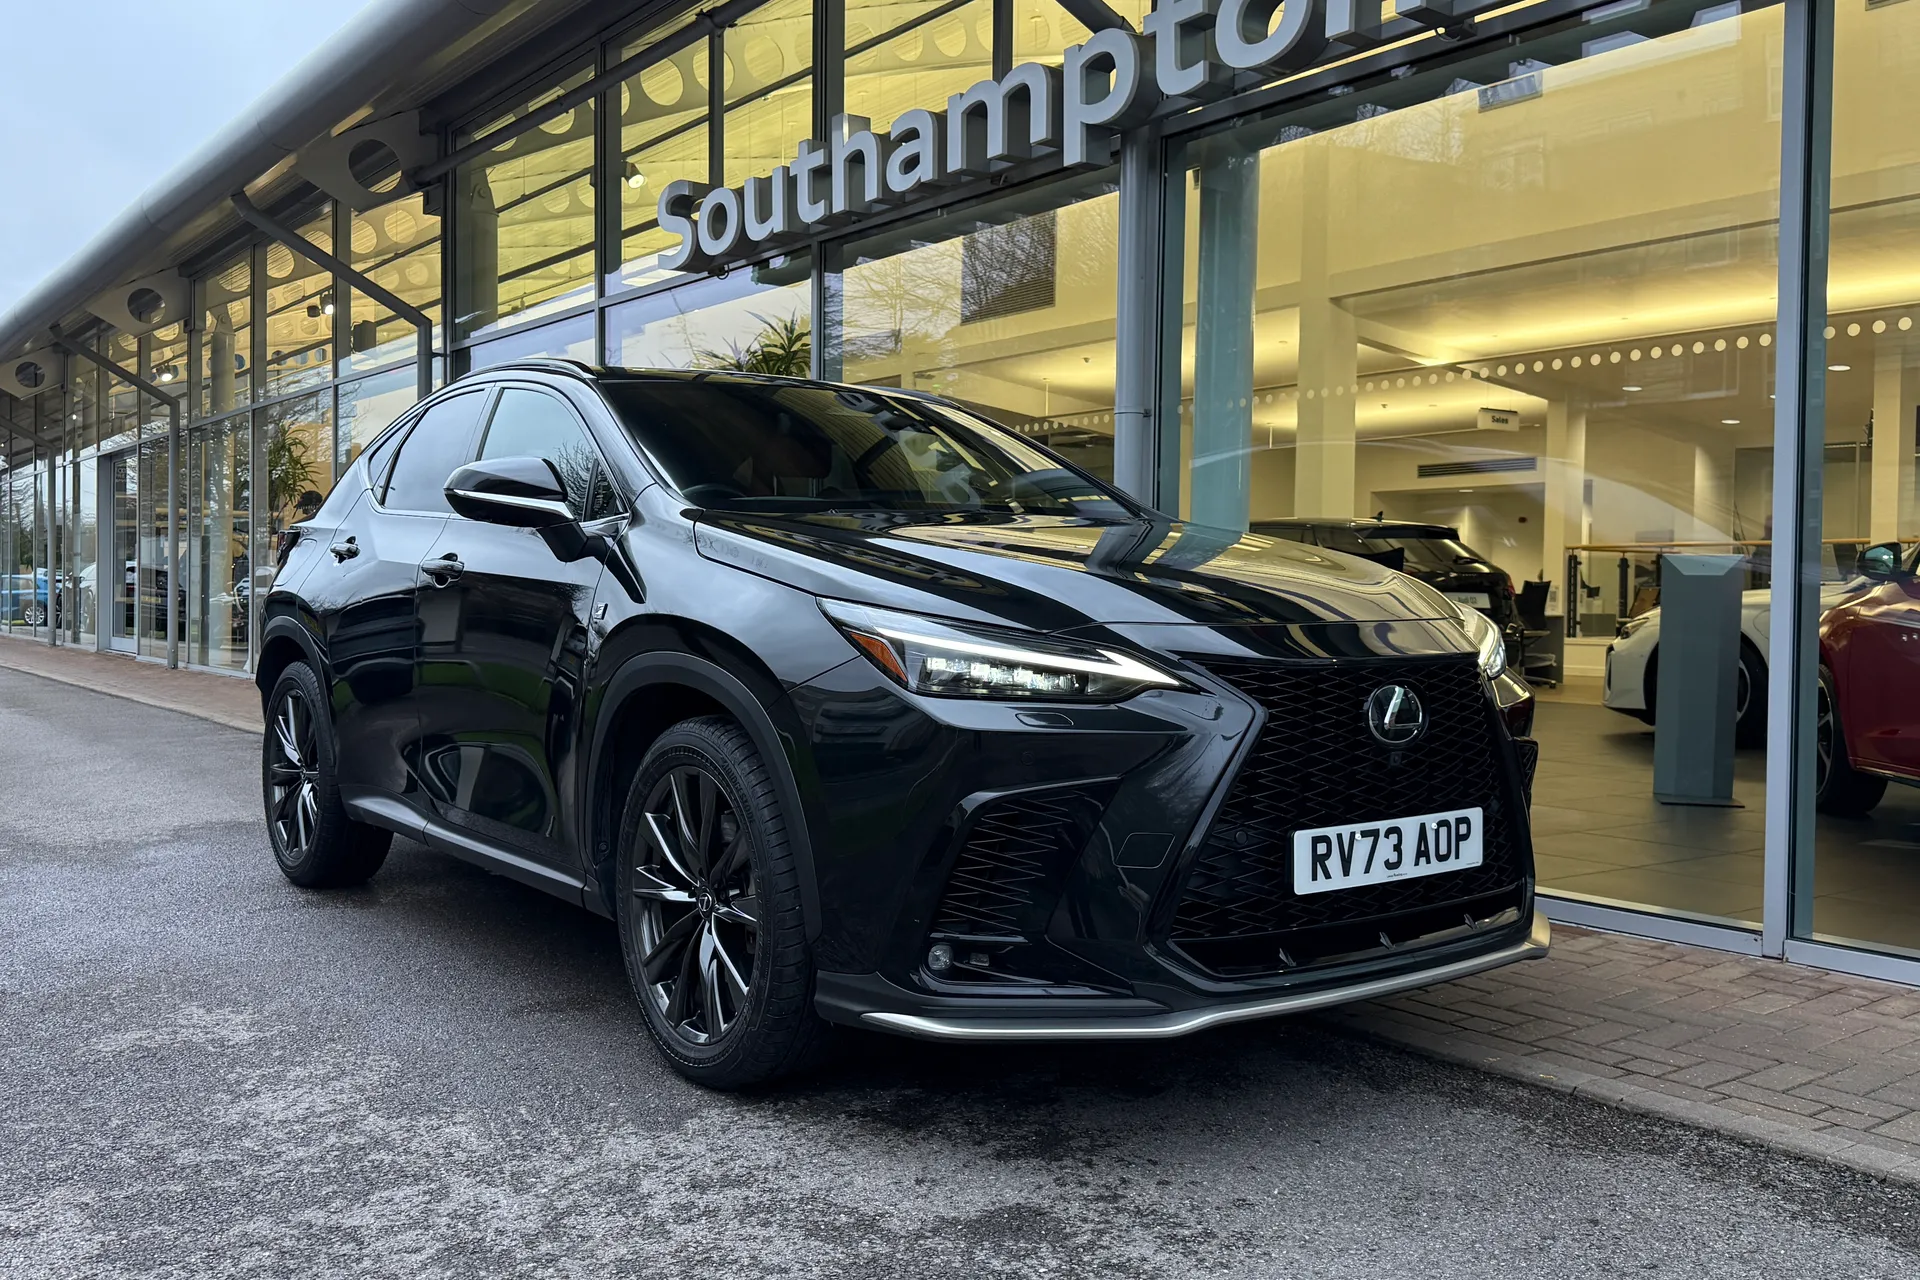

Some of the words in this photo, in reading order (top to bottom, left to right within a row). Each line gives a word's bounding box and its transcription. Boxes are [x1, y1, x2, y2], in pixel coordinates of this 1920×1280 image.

[1491, 415, 1509, 424] Sales
[1311, 826, 1403, 882] RV73
[1414, 816, 1472, 866] AOP
